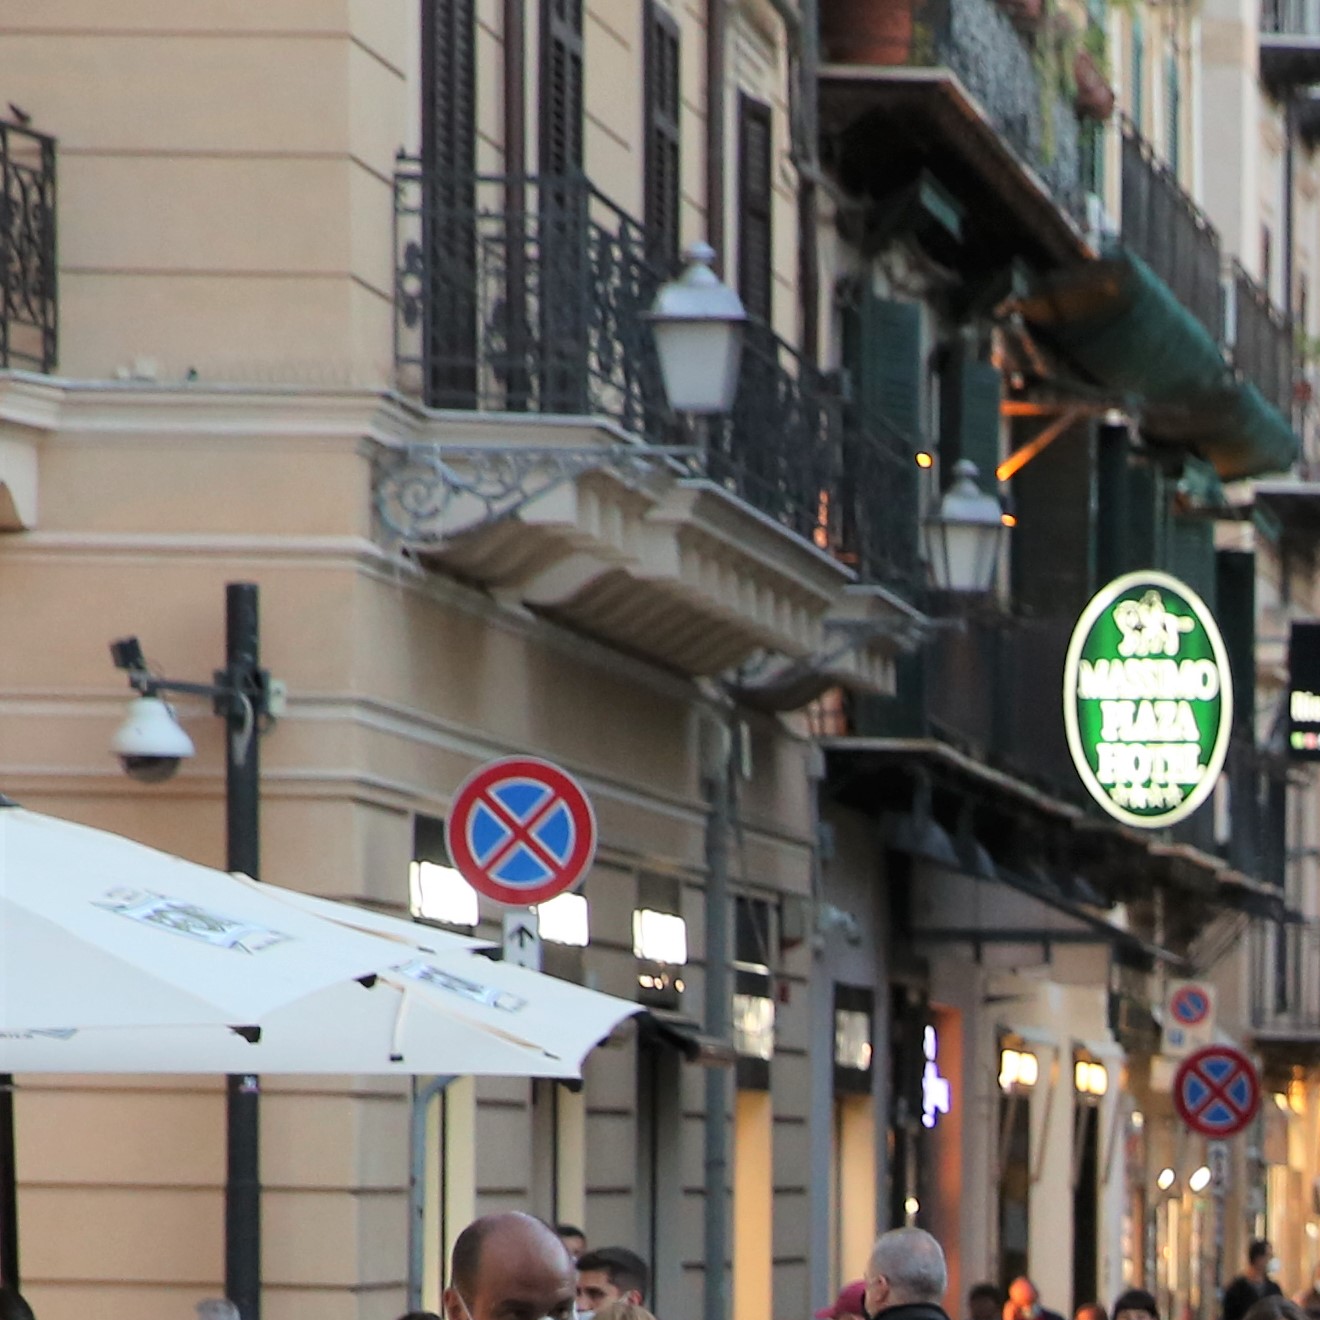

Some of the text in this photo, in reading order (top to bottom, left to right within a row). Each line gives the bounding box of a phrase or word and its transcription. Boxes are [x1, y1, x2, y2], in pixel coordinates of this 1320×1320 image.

[1077, 658, 1221, 701] MASSIMO
[1099, 700, 1200, 742] PLAZA
[1095, 741, 1206, 784] HOTEL
